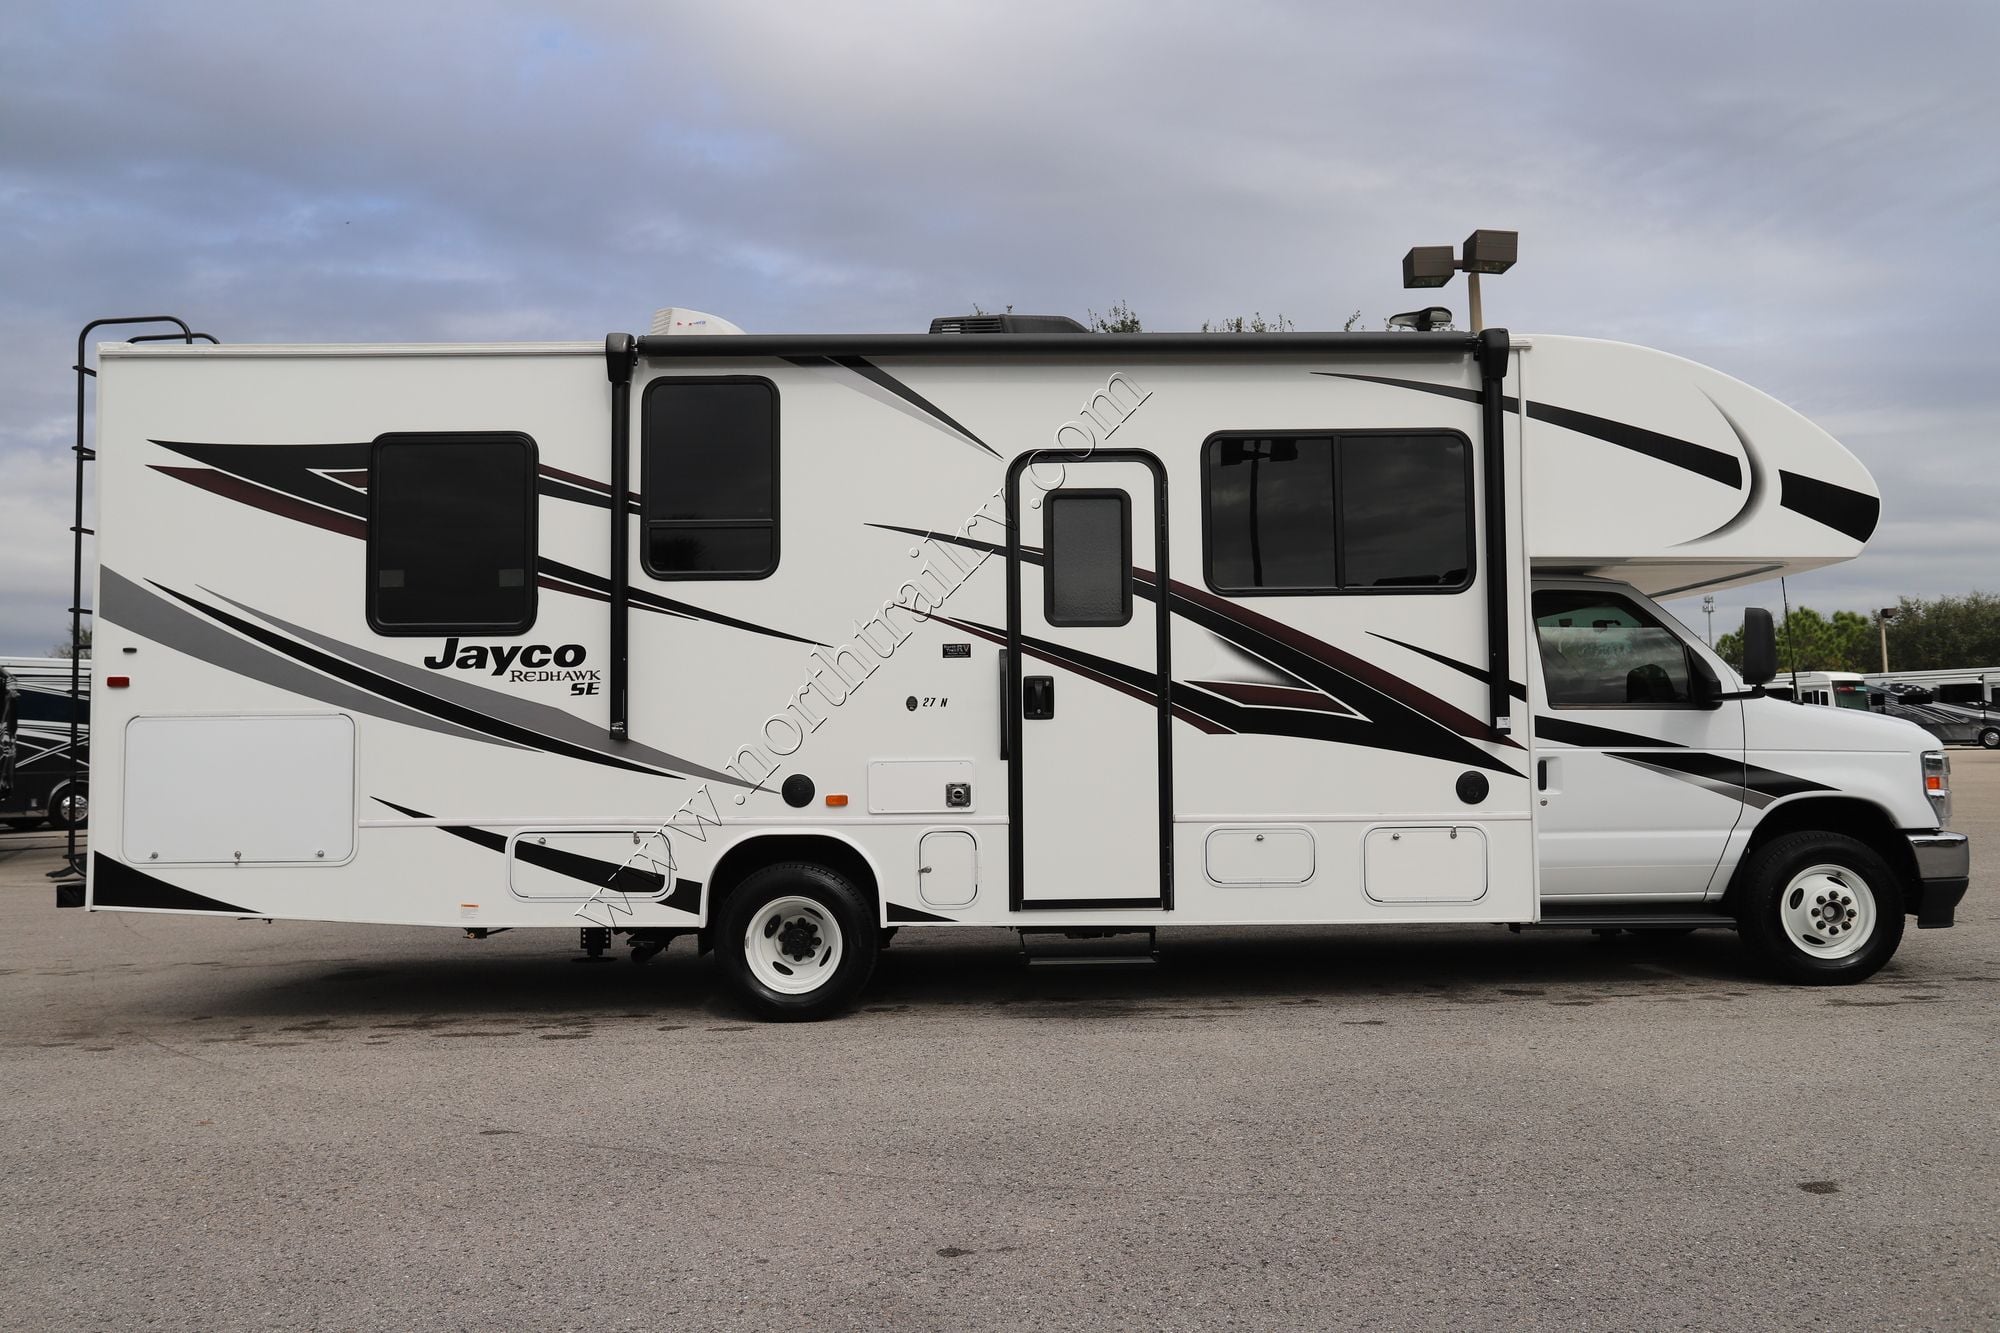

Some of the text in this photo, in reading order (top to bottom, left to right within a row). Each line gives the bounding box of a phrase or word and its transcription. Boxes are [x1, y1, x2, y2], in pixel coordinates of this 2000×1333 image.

[423, 637, 587, 676] Jayco
[509, 670, 601, 683] REDHAWK
[570, 682, 601, 696] SE
[922, 697, 936, 707] 27
[940, 697, 948, 707] N
